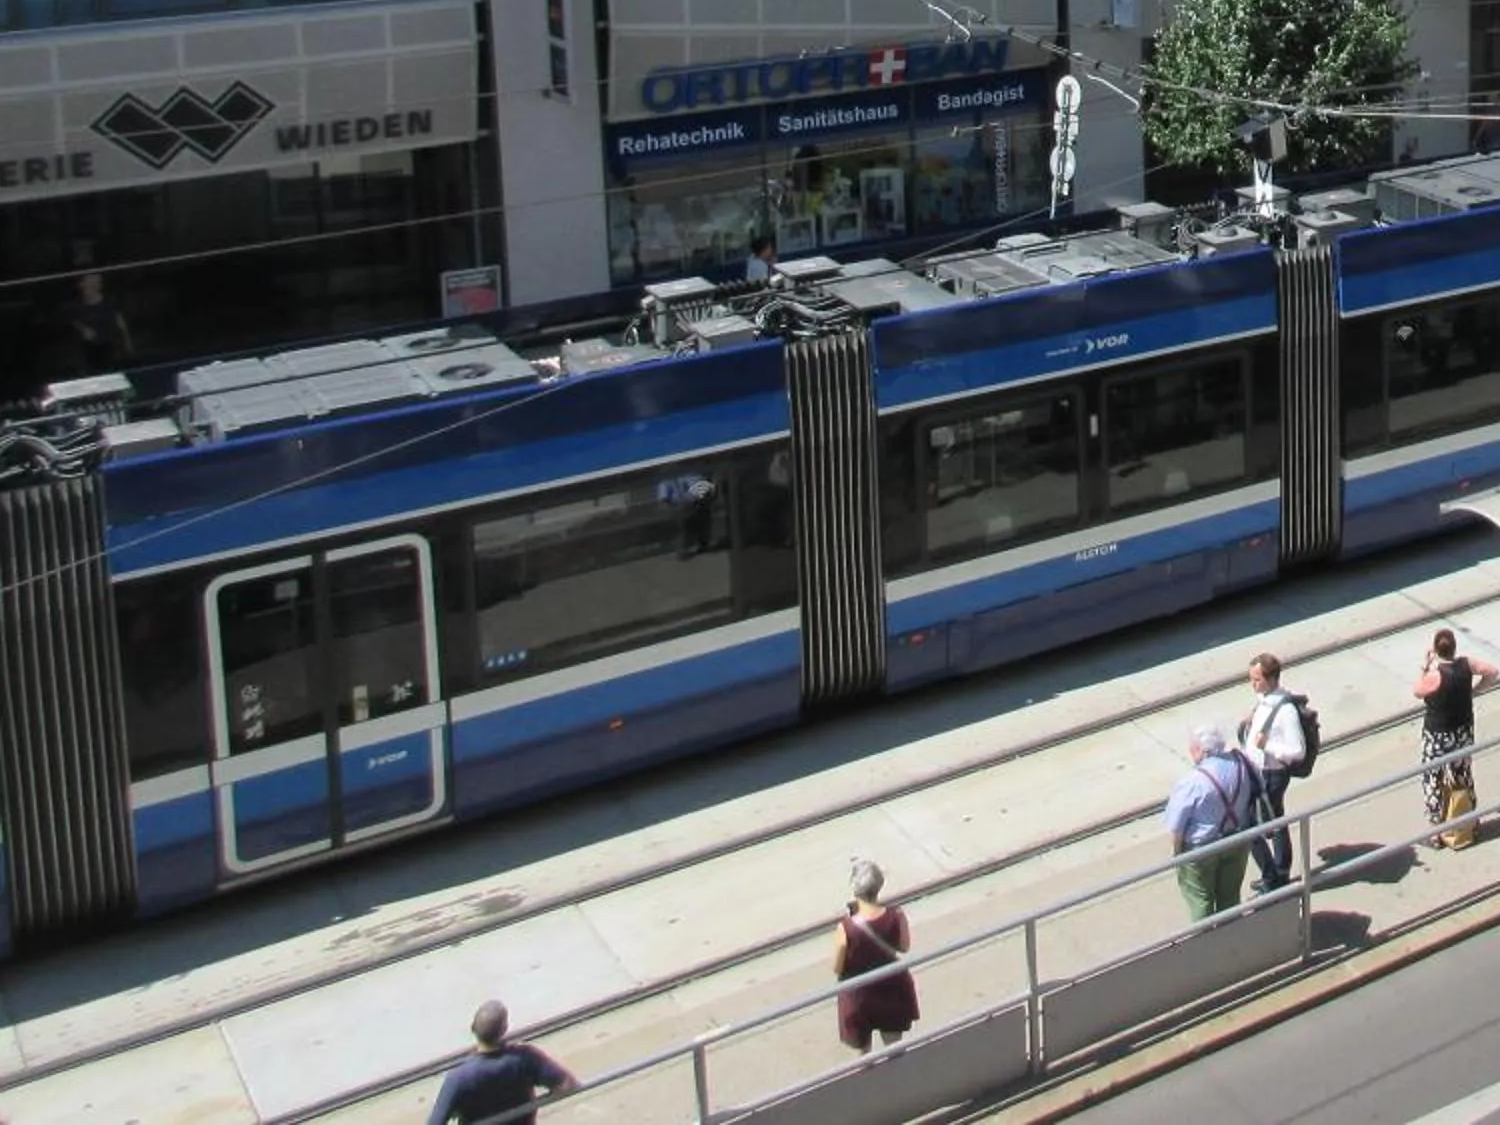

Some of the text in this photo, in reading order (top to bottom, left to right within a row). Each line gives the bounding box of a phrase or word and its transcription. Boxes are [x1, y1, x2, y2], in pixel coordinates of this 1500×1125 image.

[937, 83, 1025, 112] Bandagist
[275, 108, 433, 152] WIEDEN
[778, 103, 899, 134] Sanitätshaus
[618, 123, 744, 155] Rehatechnik
[1096, 333, 1129, 351] VOR
